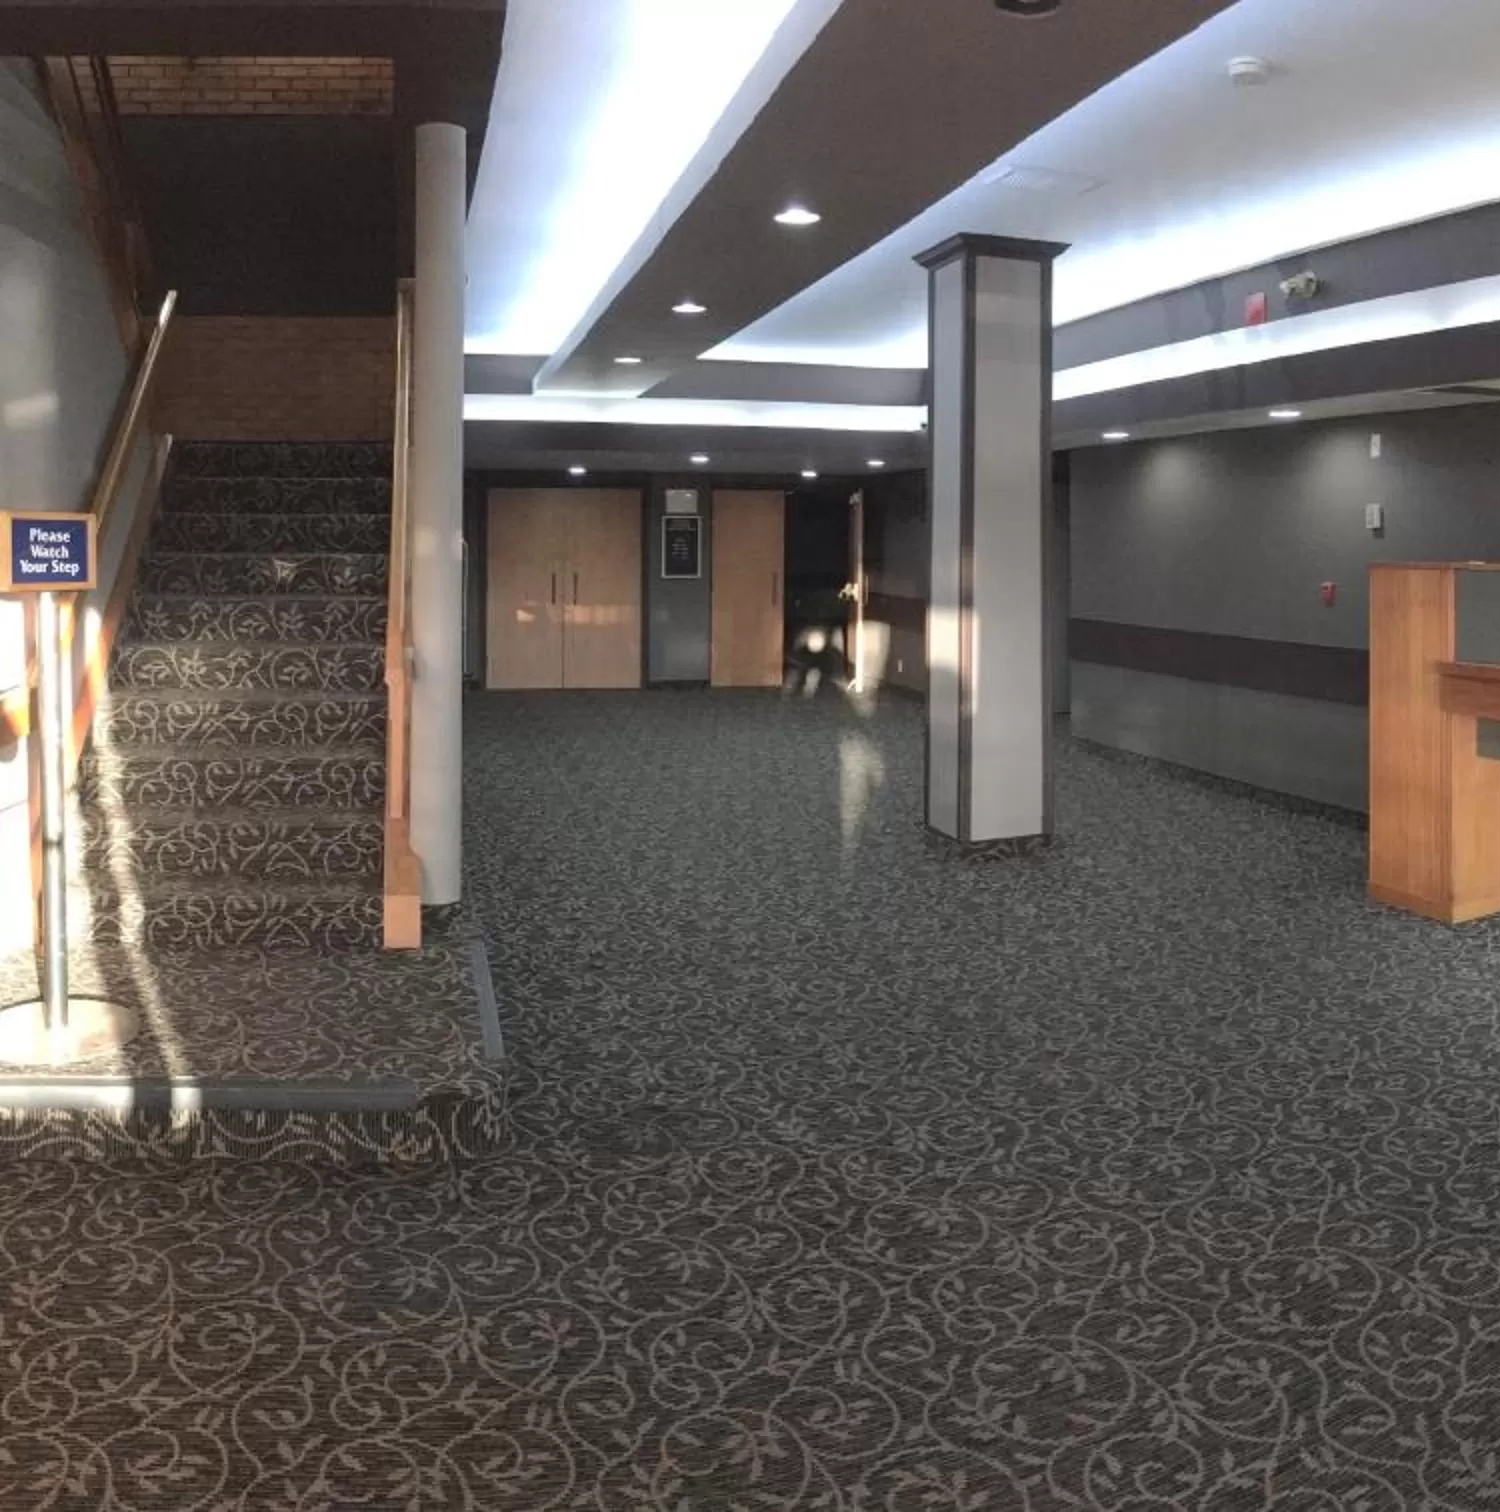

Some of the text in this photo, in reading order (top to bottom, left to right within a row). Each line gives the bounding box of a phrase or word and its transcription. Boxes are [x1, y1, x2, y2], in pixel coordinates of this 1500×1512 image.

[29, 528, 70, 543] Please
[31, 545, 69, 558] Watch
[20, 559, 80, 577] Your Step
